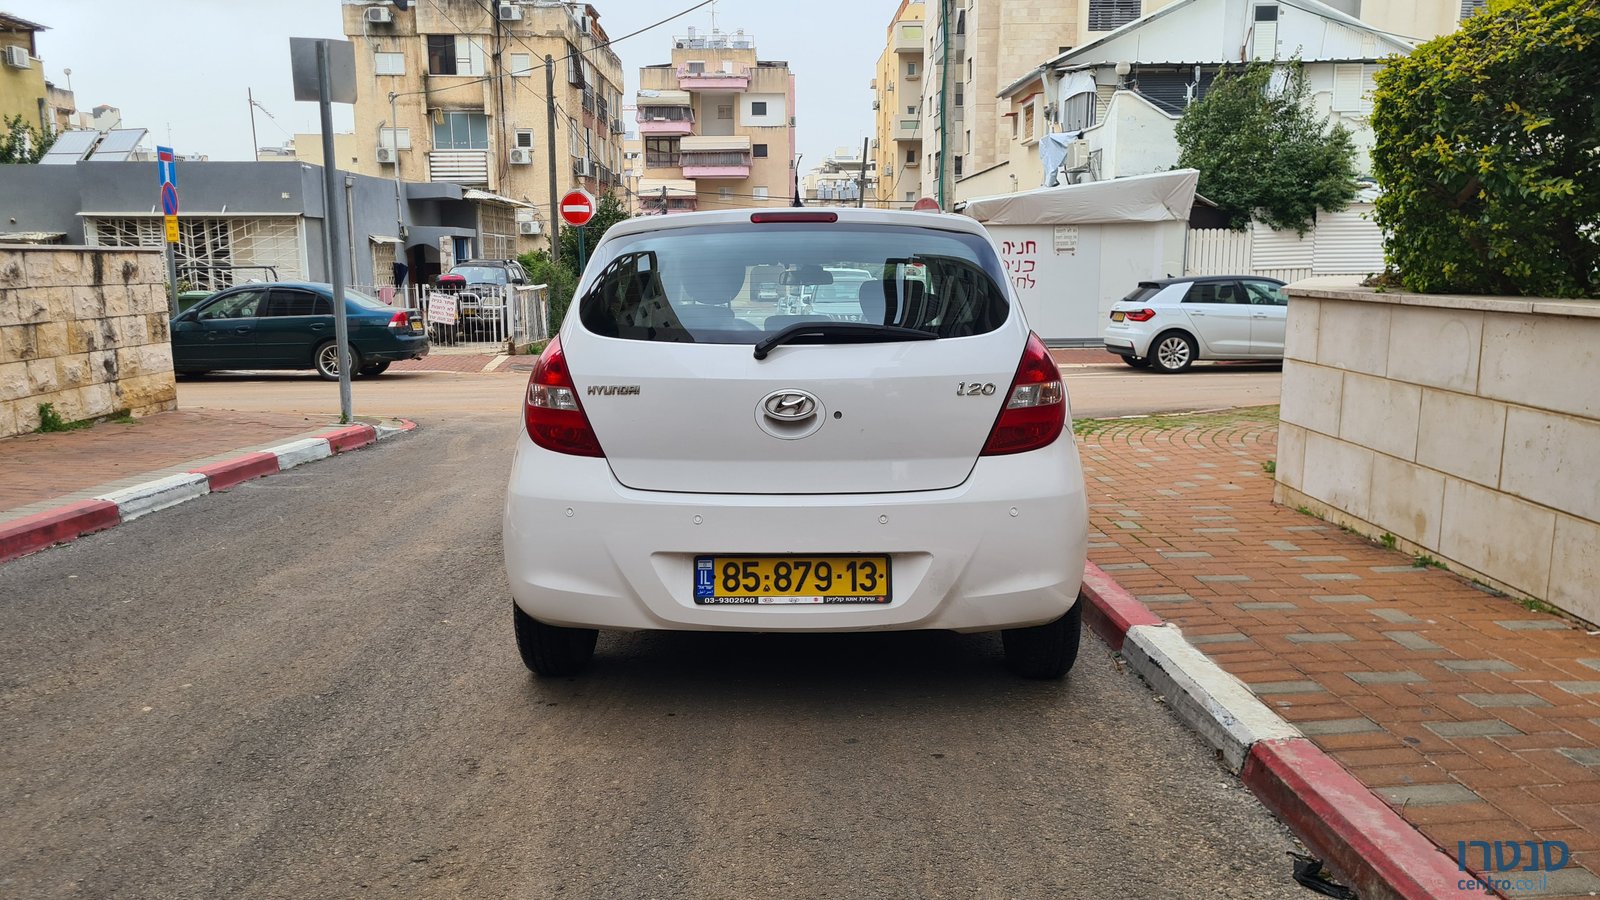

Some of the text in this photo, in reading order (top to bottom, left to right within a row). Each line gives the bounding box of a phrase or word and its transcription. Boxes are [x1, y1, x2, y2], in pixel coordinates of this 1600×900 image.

[1002, 241, 1036, 255] חניה
[587, 385, 640, 396] HYUNDAI
[957, 381, 996, 396] i20
[700, 570, 711, 585] IL
